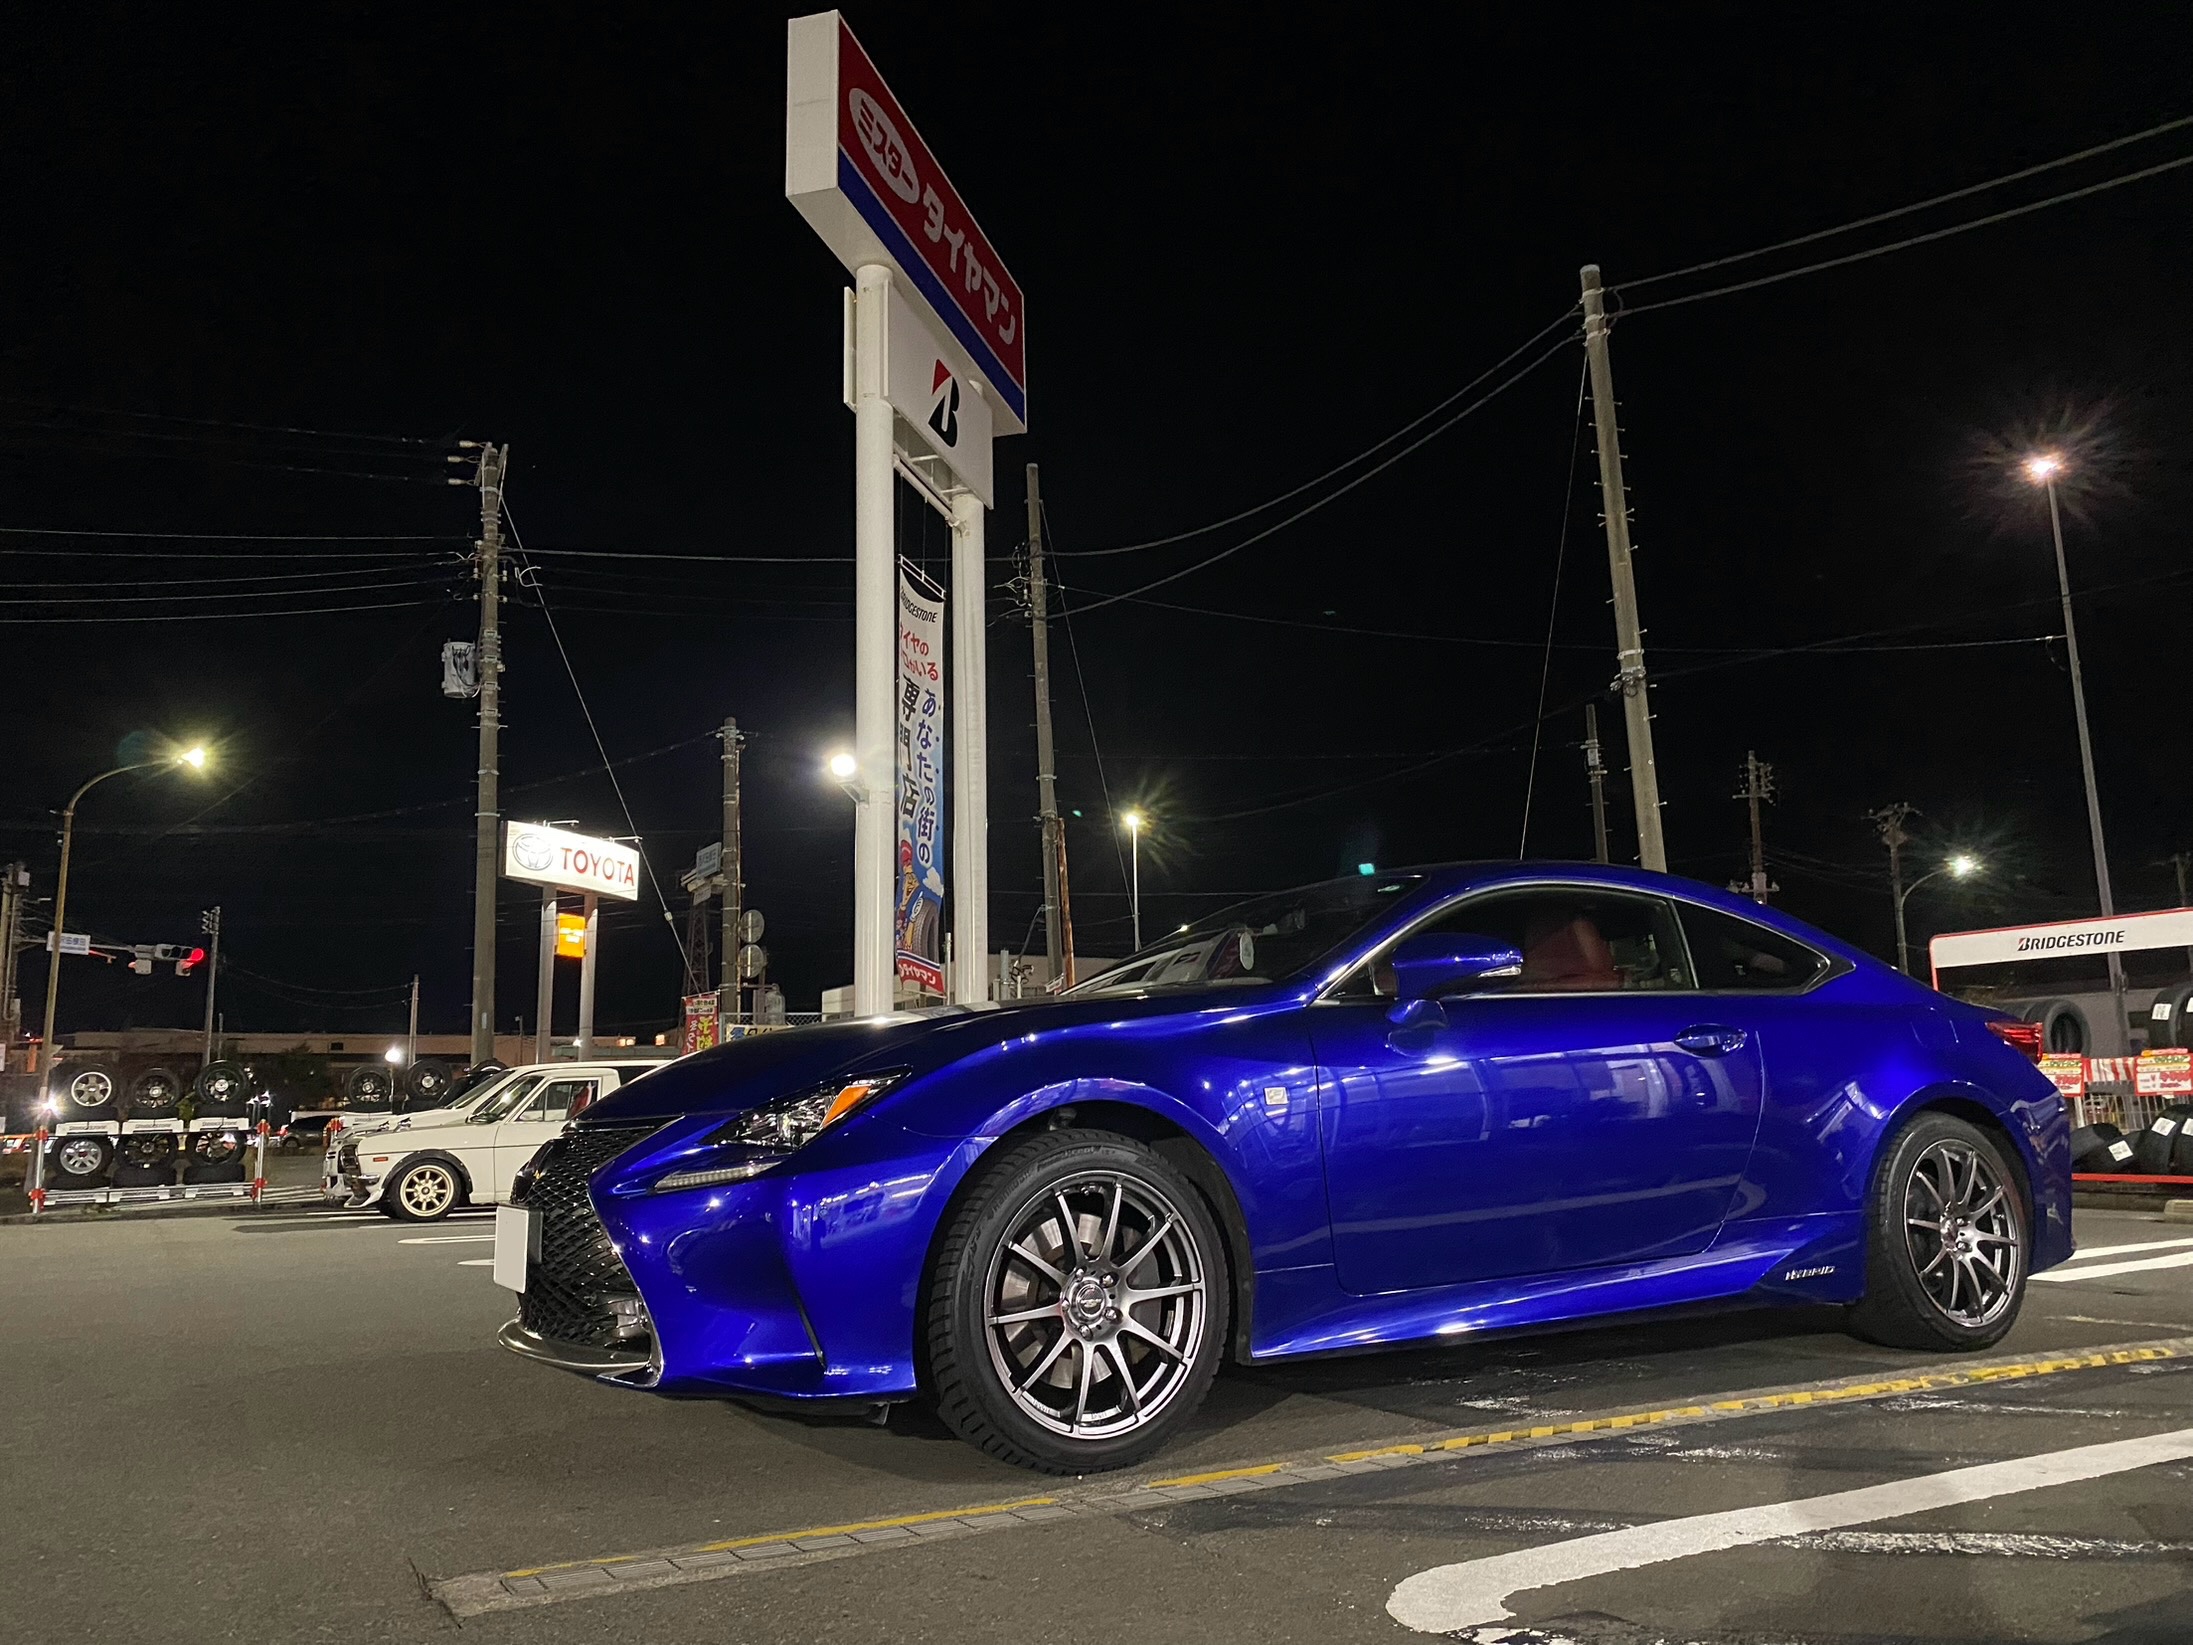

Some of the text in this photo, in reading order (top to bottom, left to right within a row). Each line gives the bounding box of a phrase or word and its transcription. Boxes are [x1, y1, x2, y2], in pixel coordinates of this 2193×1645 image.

[858, 98, 1016, 345] ミスター タイヤマン
[902, 649, 939, 681] ロがいる
[917, 688, 936, 864] あなたの街の
[560, 847, 635, 887] TOYOTA
[2017, 931, 2125, 951] BRIDGESTONE
[1785, 1265, 1835, 1281] HYBRID
